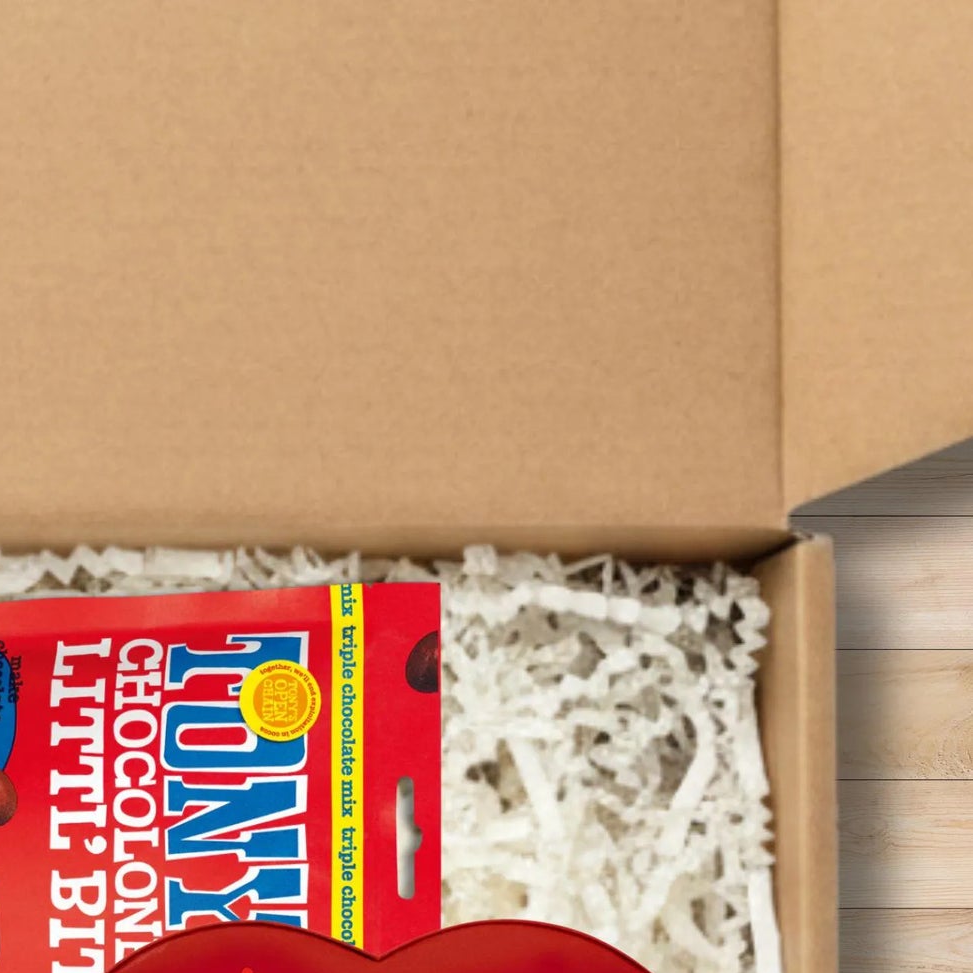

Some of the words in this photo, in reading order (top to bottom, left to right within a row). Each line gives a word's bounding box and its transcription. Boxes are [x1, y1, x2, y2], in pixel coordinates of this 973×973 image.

[339, 625, 358, 679] triple
[7, 655, 24, 704] make
[262, 678, 274, 722] CHAIN
[274, 678, 288, 723] OPEN
[49, 637, 112, 855] LITTL'
[341, 683, 356, 776] chocolate
[341, 780, 357, 817] mix
[338, 826, 358, 881] triple
